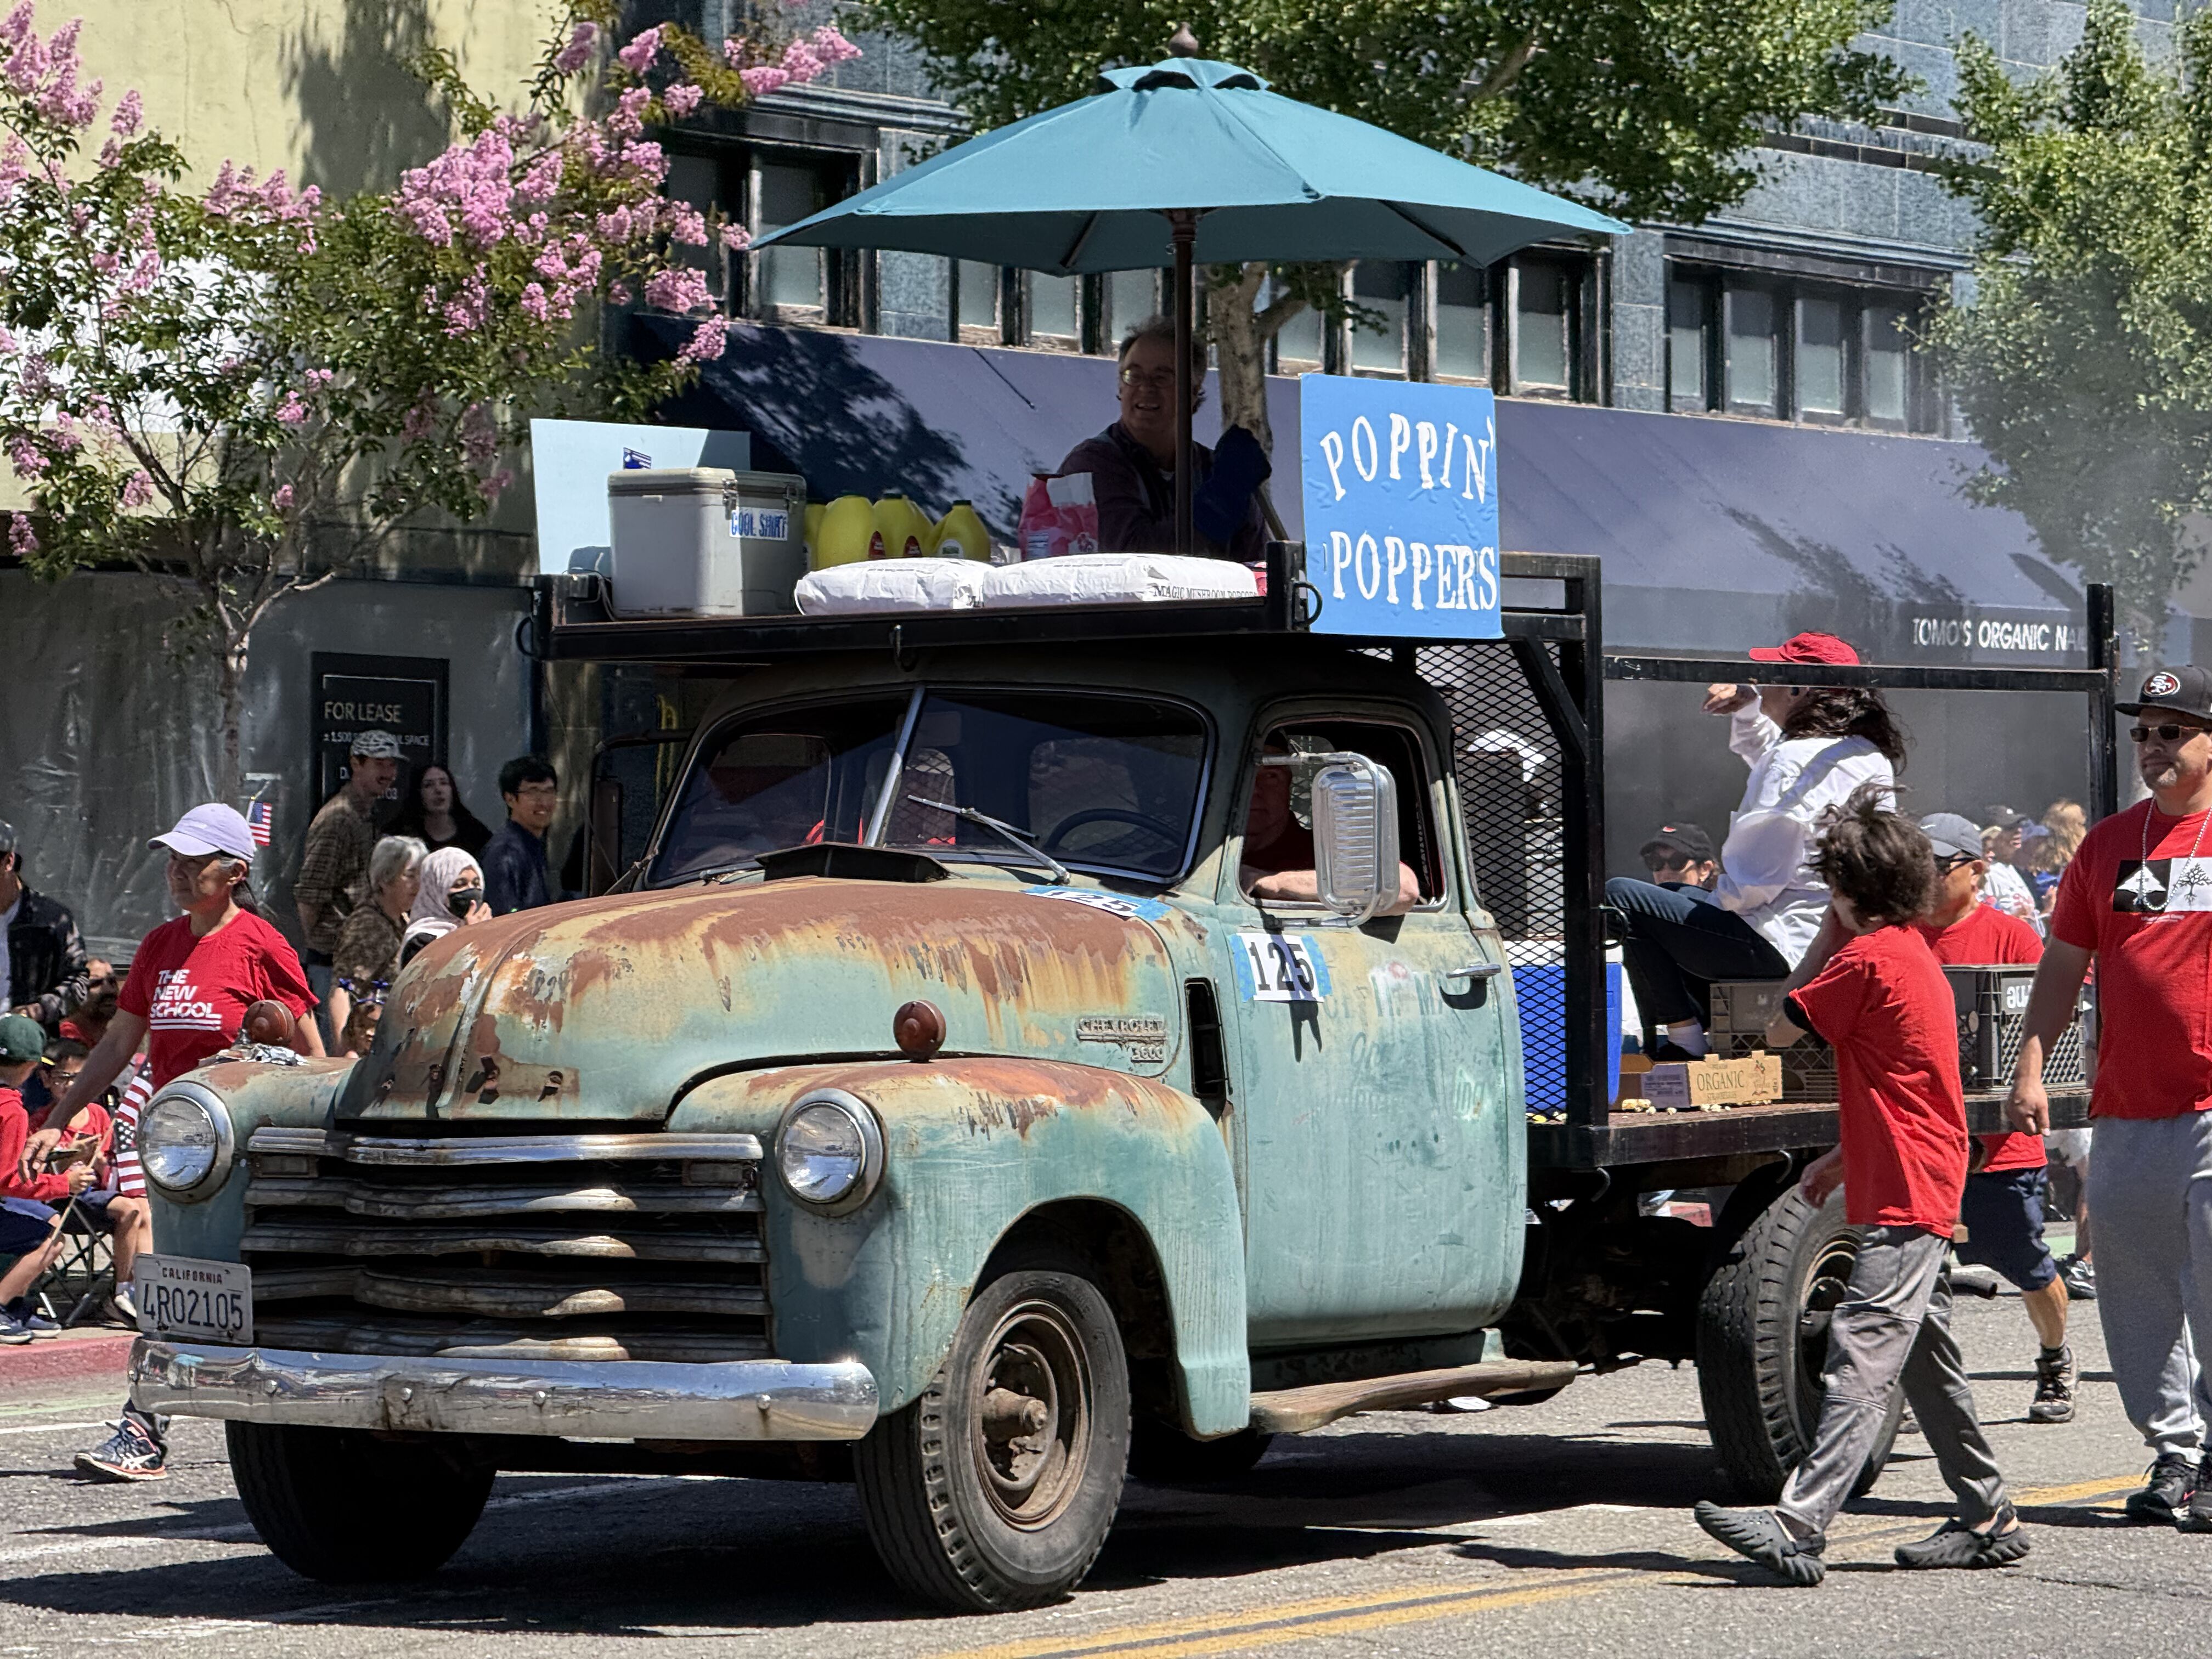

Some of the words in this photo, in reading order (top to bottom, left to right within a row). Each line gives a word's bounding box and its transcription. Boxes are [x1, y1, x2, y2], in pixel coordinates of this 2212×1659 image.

[1320, 413, 1494, 504] POPPIN'
[731, 511, 757, 537] COOL
[1330, 531, 1497, 611] POPPERS
[1153, 586, 1184, 600] MAGIC
[1912, 618, 1972, 646] TOMO'S
[1978, 620, 2050, 651] ORGANIC
[324, 702, 356, 720] FOR
[358, 703, 402, 723] LEASE
[159, 969, 190, 985] THE
[1249, 941, 1314, 992] 125
[153, 985, 198, 1001] NEW
[150, 1002, 222, 1019] SCHOOL
[1080, 1018, 1164, 1033] CHEVROLET
[1132, 1046, 1163, 1060] 3600
[1696, 1070, 1745, 1091] ORGANIC
[162, 1267, 223, 1285] CALIFORNIA
[143, 1283, 243, 1331] 4R02105
